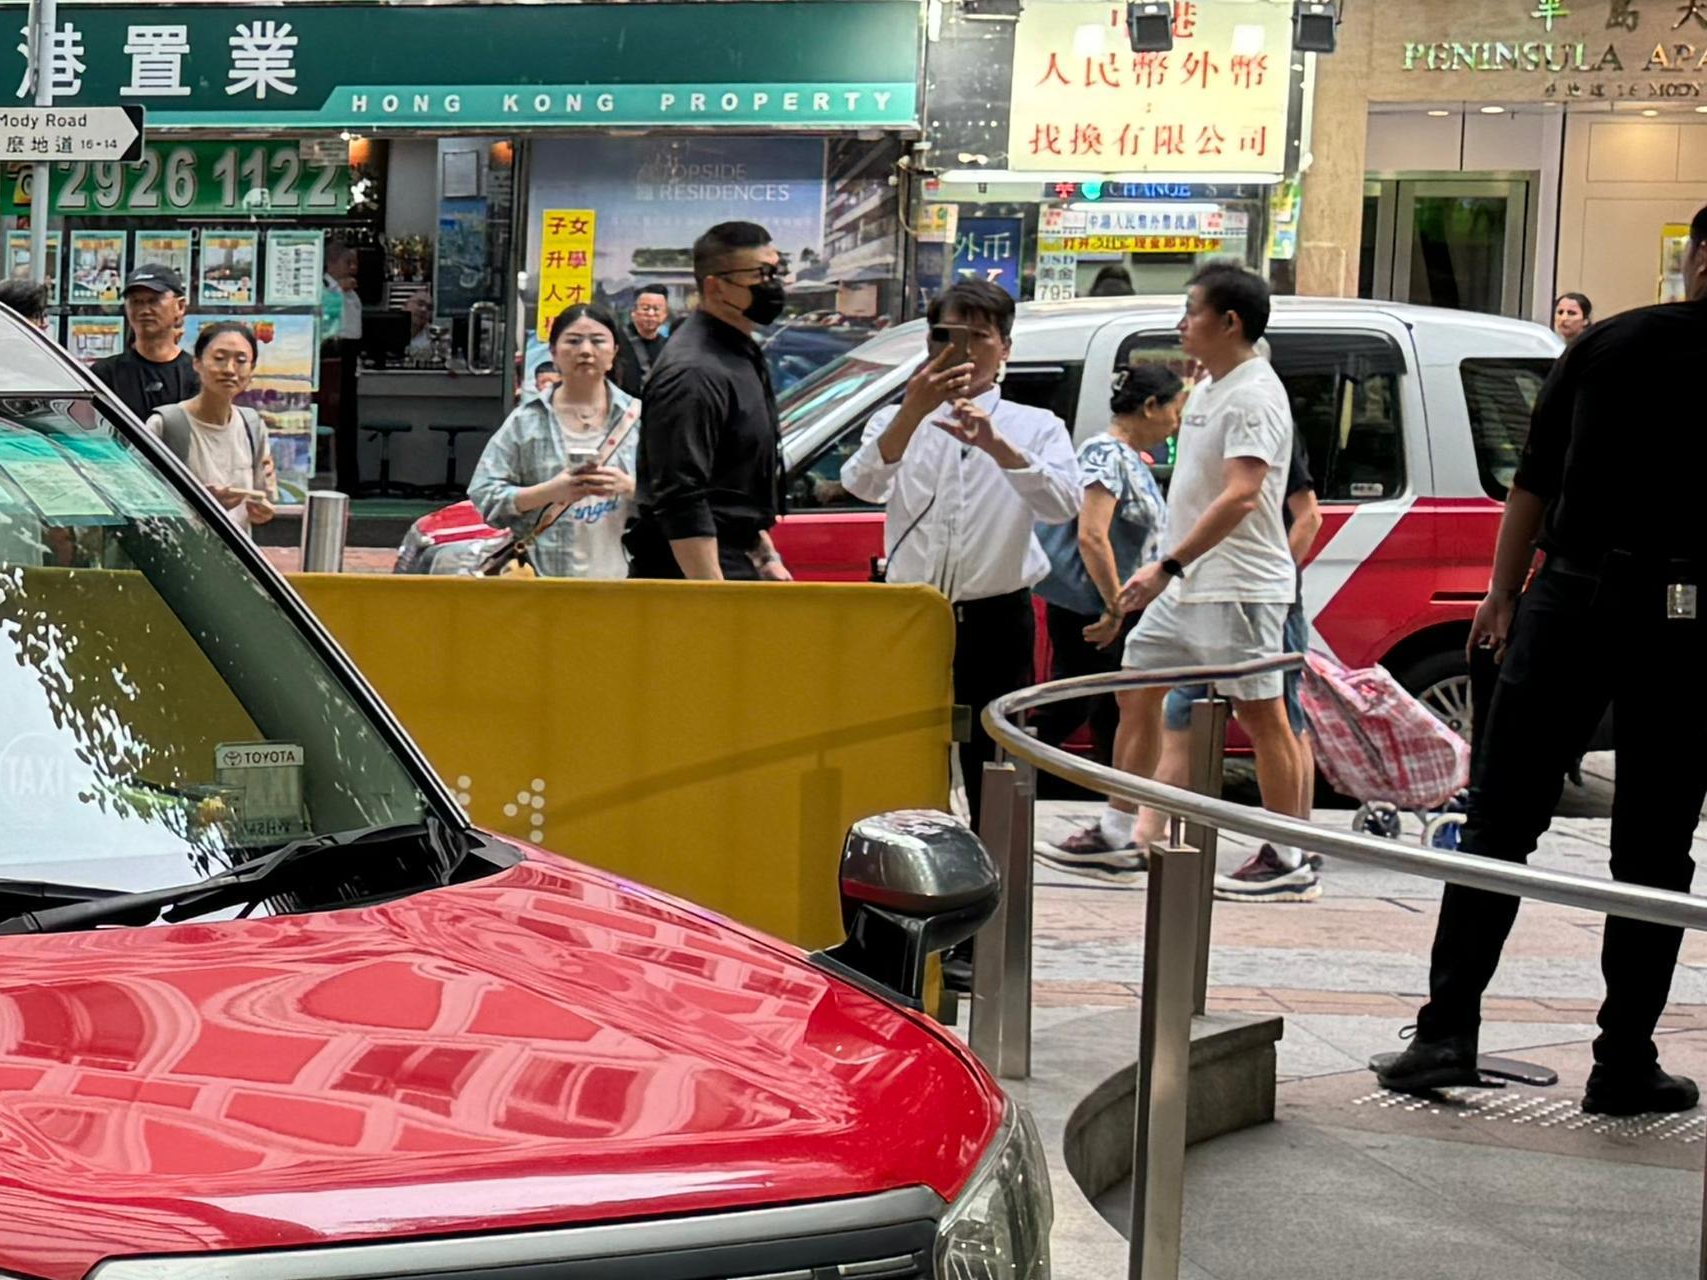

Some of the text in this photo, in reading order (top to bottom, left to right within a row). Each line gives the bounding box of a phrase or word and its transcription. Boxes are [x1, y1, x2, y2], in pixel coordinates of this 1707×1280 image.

[1401, 41, 1624, 73] PENINSULA
[1033, 50, 1269, 89] 人民幣外幣
[351, 91, 893, 114] HONG KONG PROPERTY
[46, 113, 88, 127] Road
[1027, 122, 1269, 157] 找換有限公司
[57, 145, 338, 209] 2926 1122
[659, 183, 790, 202] RESIDENCES
[548, 216, 589, 236] 子女
[545, 250, 588, 269] 升學
[543, 284, 586, 303] 人才
[244, 751, 296, 765] TOYOTA
[5, 755, 66, 797] TAXI
